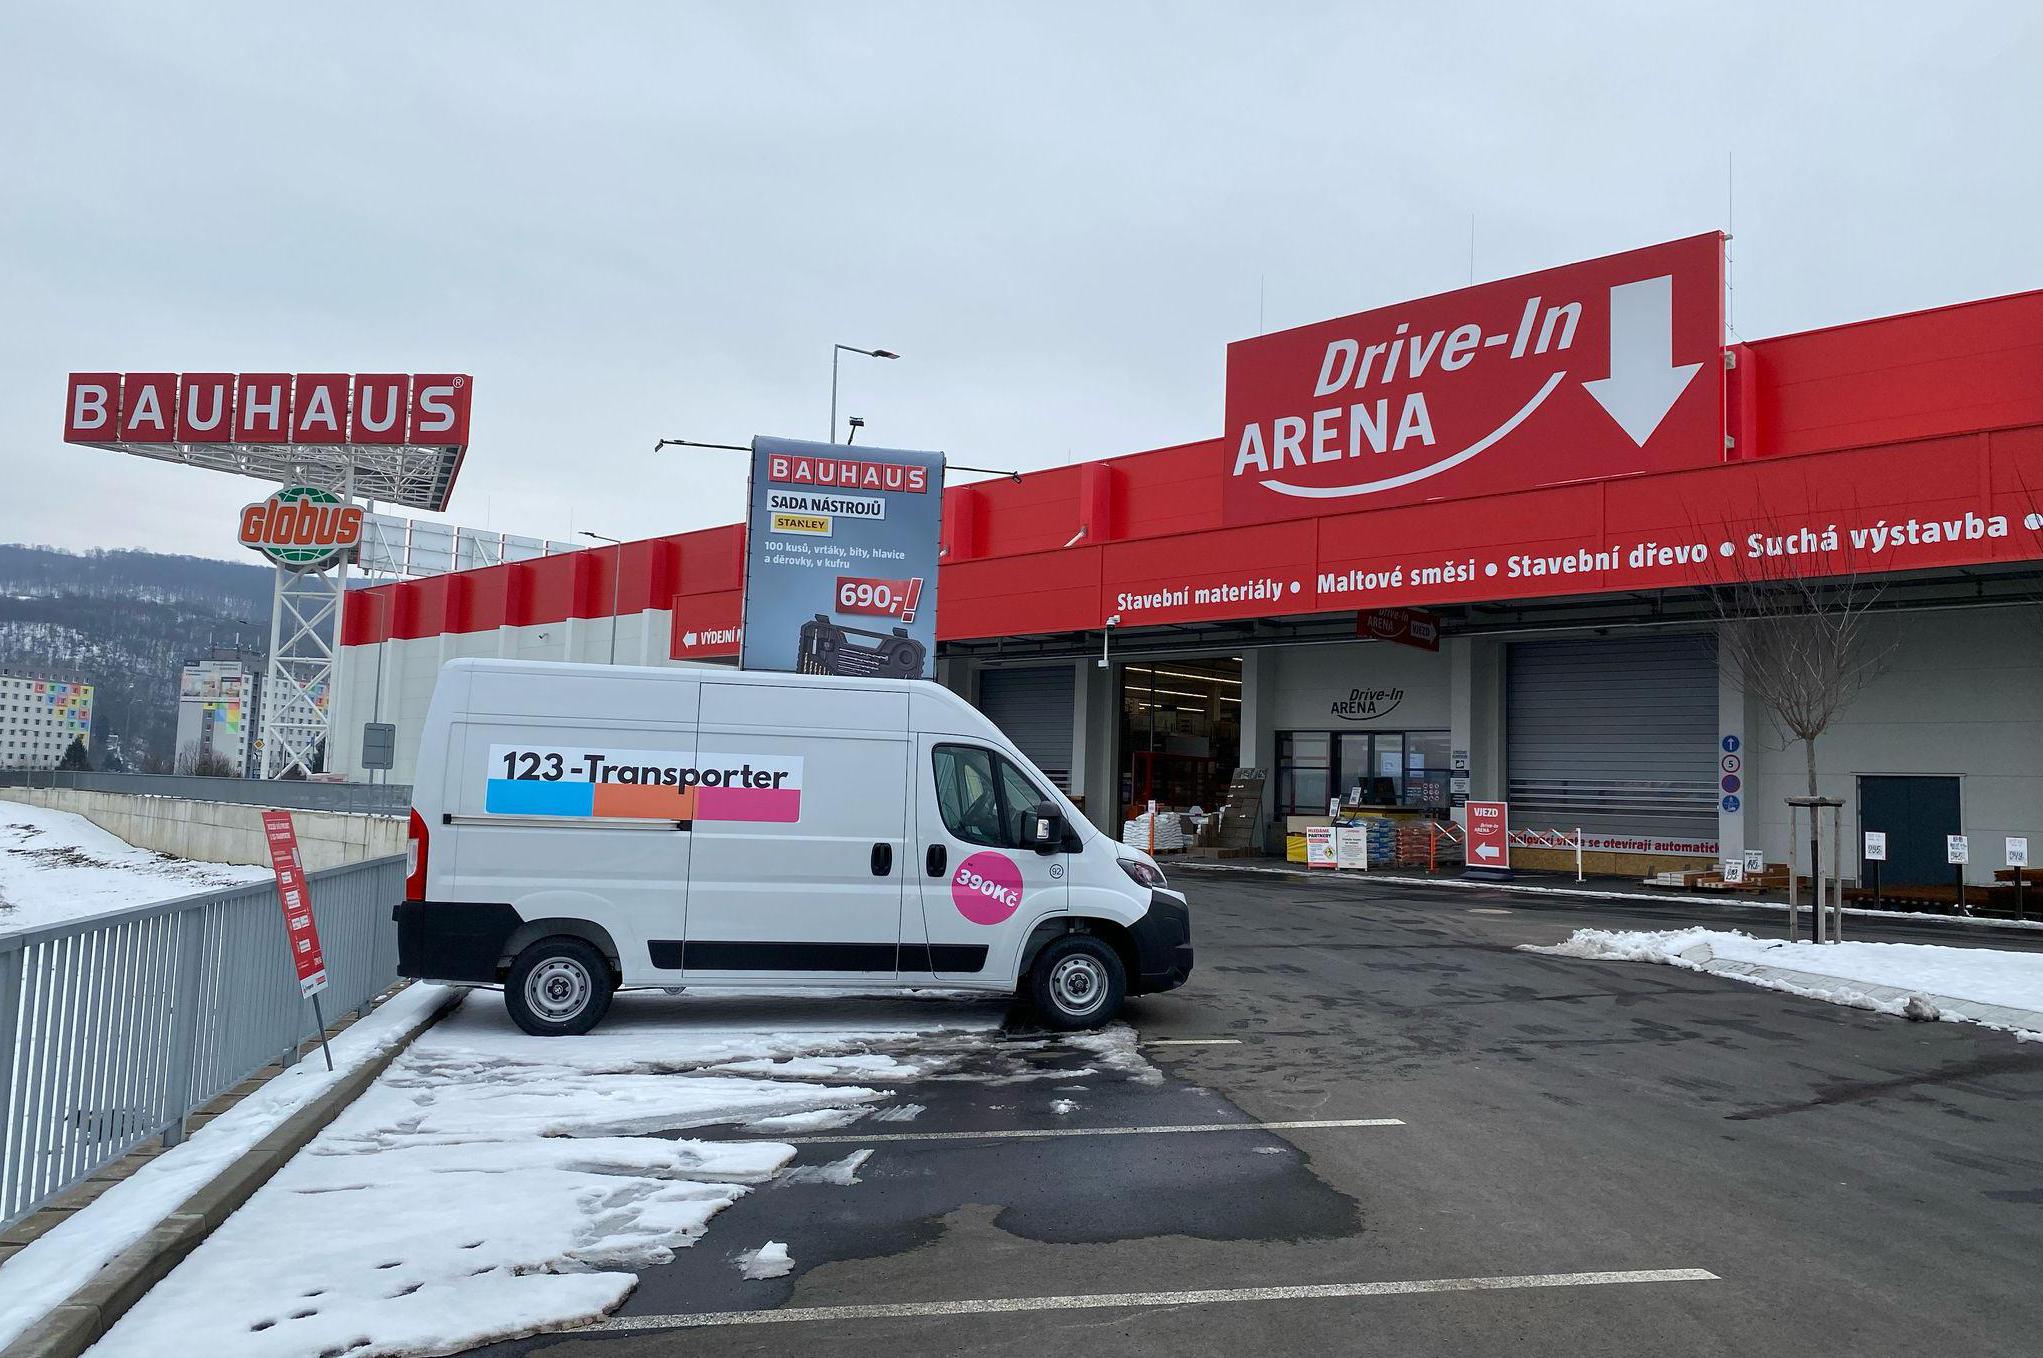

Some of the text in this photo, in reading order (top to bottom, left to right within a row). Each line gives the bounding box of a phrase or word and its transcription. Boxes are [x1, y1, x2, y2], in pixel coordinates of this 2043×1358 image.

[1313, 296, 1583, 397] Drive-In
[1233, 392, 1436, 476] ARENA
[771, 458, 924, 489] BAUHAUS
[771, 495, 881, 516] SADA NÁSTROJŮ
[777, 517, 825, 530] STANLEY
[764, 541, 905, 560] 100 kusů, vrtáky, bity, hlavice
[772, 554, 814, 568] děrovky,
[824, 558, 850, 569] kufru
[1117, 512, 2008, 612] Stavební materiály Maltové směsi Stavební dřevo Suchá výstavba
[700, 626, 737, 645] VÝDEJNÍ
[1350, 688, 1404, 700] Drive-In
[1331, 701, 1376, 714] ARENA
[503, 751, 789, 795] 123-Transporter
[1728, 760, 1734, 768] 5
[1473, 807, 1499, 818] VJEZD
[1588, 839, 1600, 848] se
[1603, 838, 1651, 853] otevírají
[956, 868, 1019, 907] 390Kč
